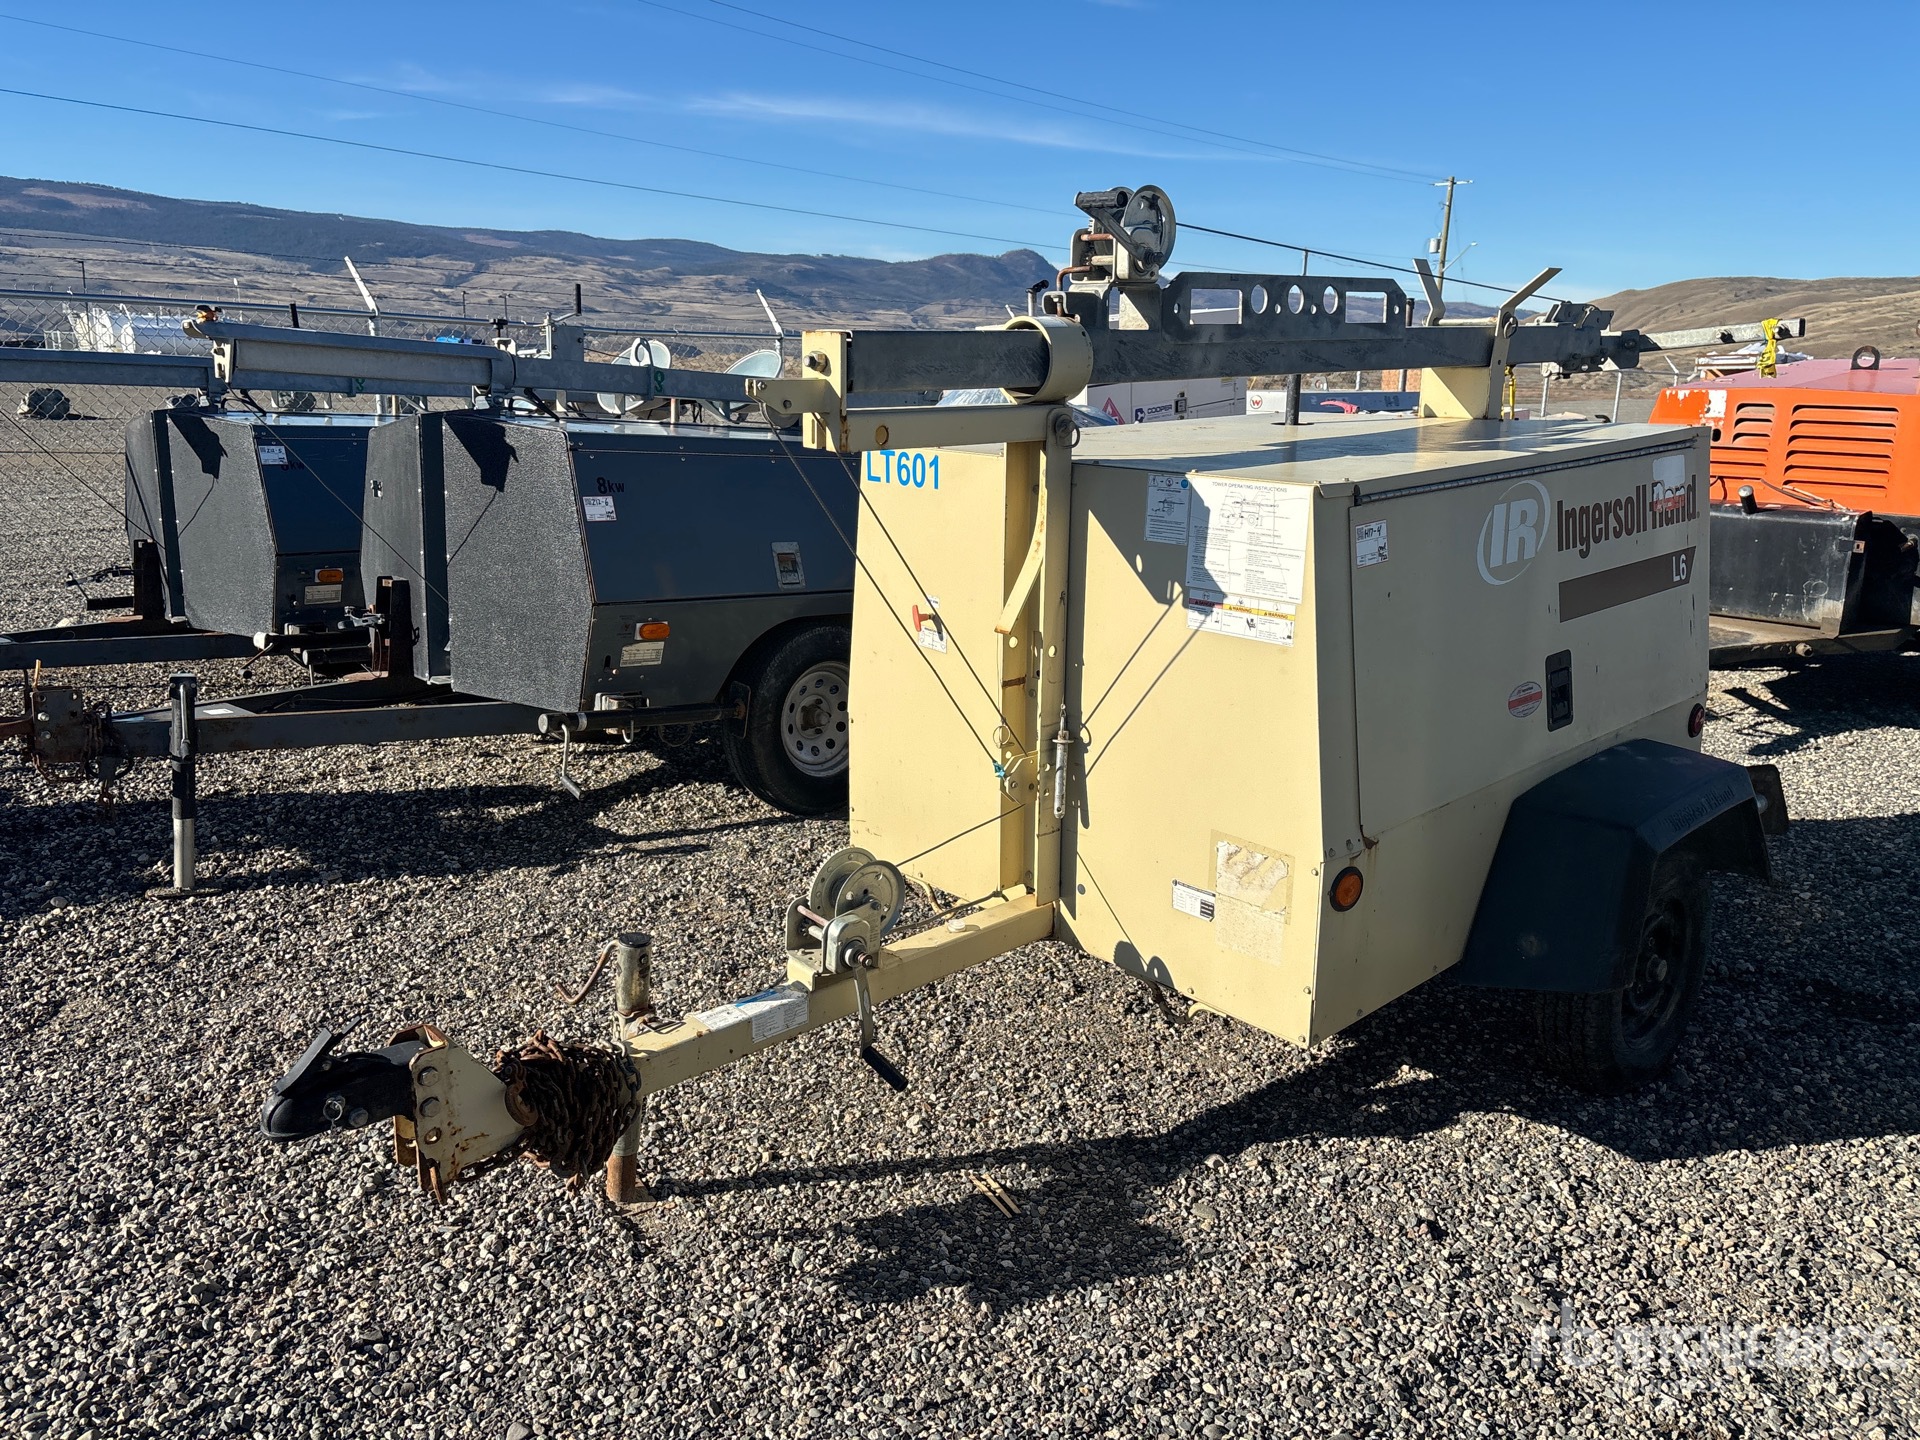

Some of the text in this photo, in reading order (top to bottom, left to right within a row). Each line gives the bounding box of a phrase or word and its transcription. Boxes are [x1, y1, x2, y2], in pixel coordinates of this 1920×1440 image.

[1147, 404, 1173, 414] COOPER
[866, 449, 940, 490] LT601
[1254, 485, 1288, 493] INSTRUCTIONS
[1489, 497, 1539, 569] IR
[1671, 553, 1687, 583] L6
[1232, 606, 1253, 614] WARNING
[1267, 612, 1289, 620] WARNING
